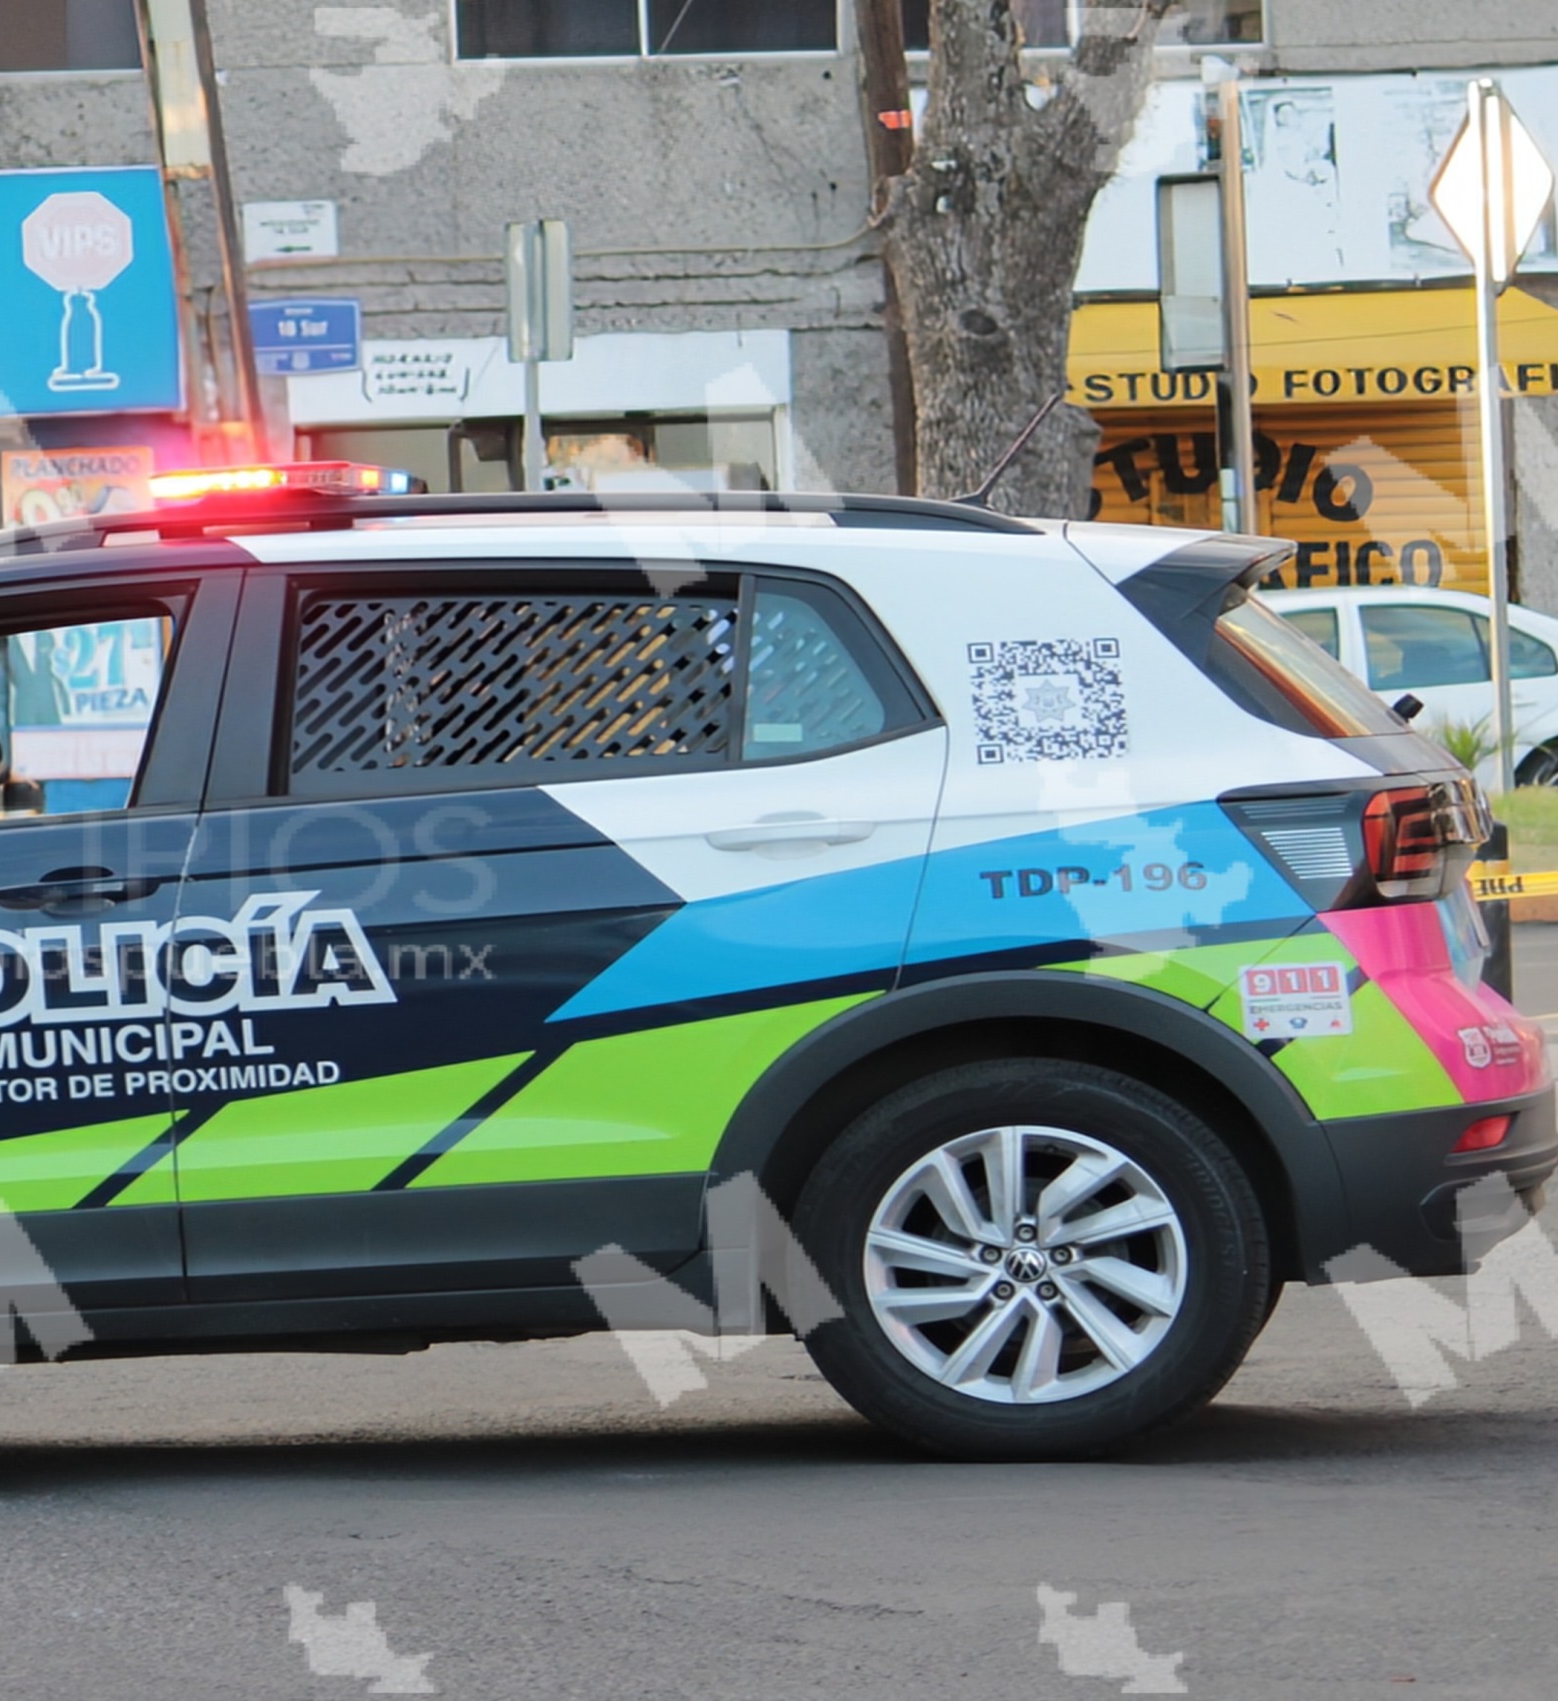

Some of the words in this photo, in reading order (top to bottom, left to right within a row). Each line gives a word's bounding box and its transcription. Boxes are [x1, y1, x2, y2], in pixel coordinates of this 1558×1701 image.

[9, 454, 143, 478] PLANCHADO
[75, 689, 149, 714] PIEZA
[979, 861, 1208, 899] TDP-196
[1251, 968, 1333, 994] 911
[70, 1071, 115, 1098] DE
[124, 1060, 340, 1095] PROXIMIDAD
